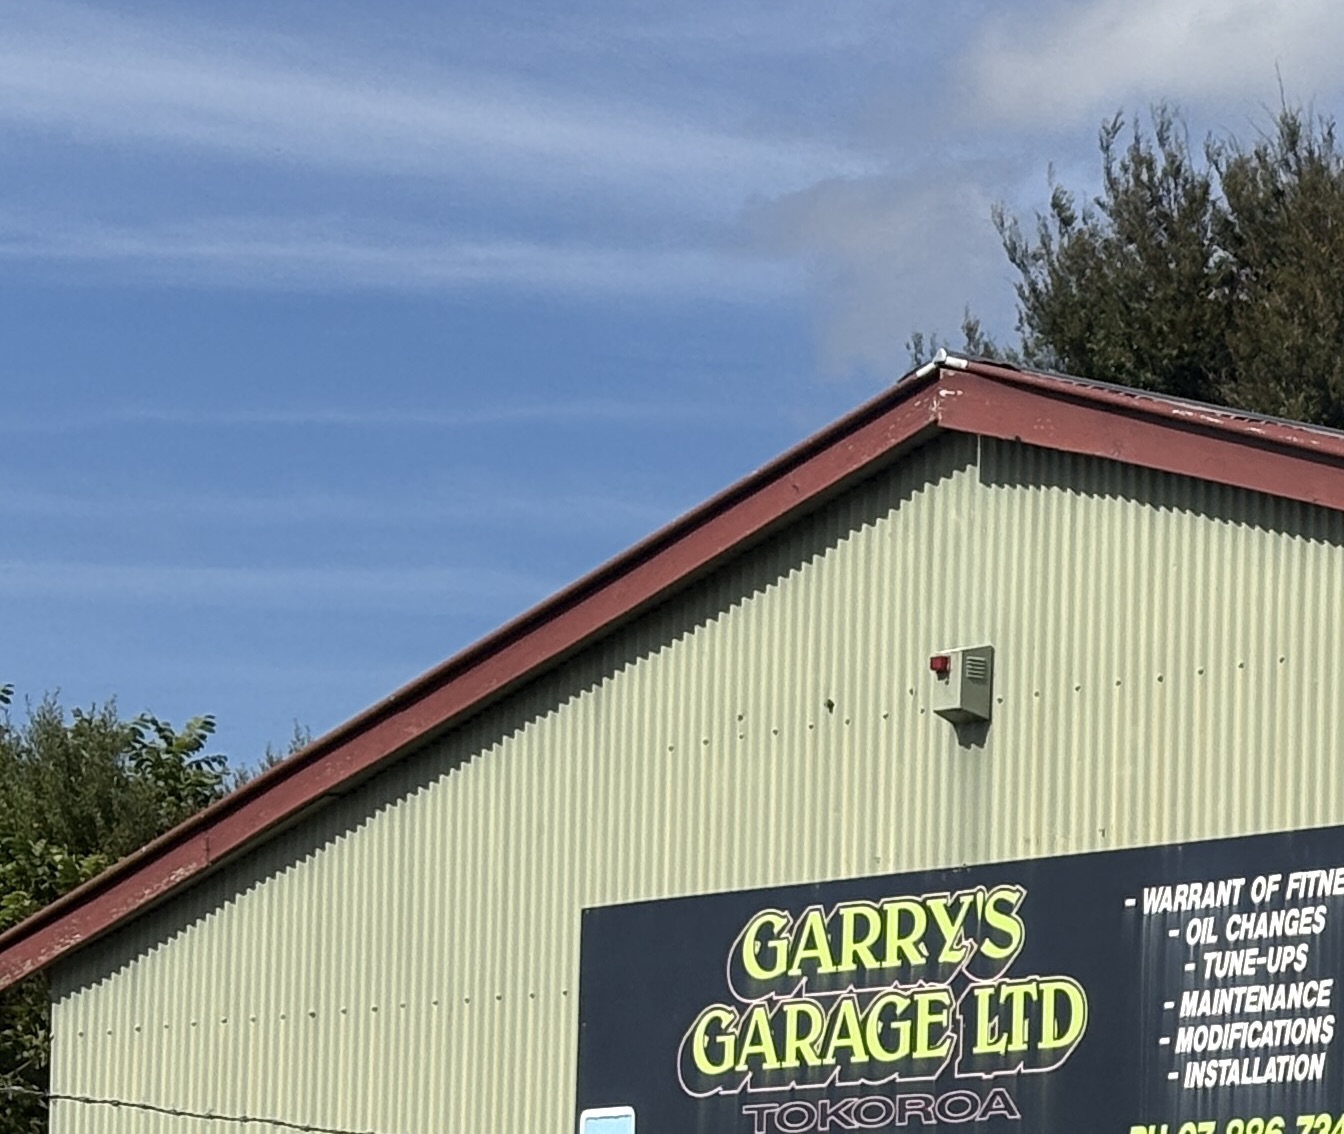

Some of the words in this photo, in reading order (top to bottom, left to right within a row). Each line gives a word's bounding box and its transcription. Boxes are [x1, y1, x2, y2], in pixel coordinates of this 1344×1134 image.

[1143, 877, 1246, 915] WARRANT
[1250, 873, 1282, 904] OF
[741, 890, 1025, 981] GARRY'S
[1186, 916, 1218, 946] OIL
[1225, 905, 1328, 942] CHANGES
[1203, 943, 1309, 980] TUNE-UPS
[1179, 979, 1334, 1018] MAINTENANCE
[692, 986, 953, 1076] GARAGE
[972, 981, 1087, 1055] LTD
[1175, 1015, 1335, 1054] MODIFICATIONS
[1184, 1052, 1326, 1089] INSTALLATION
